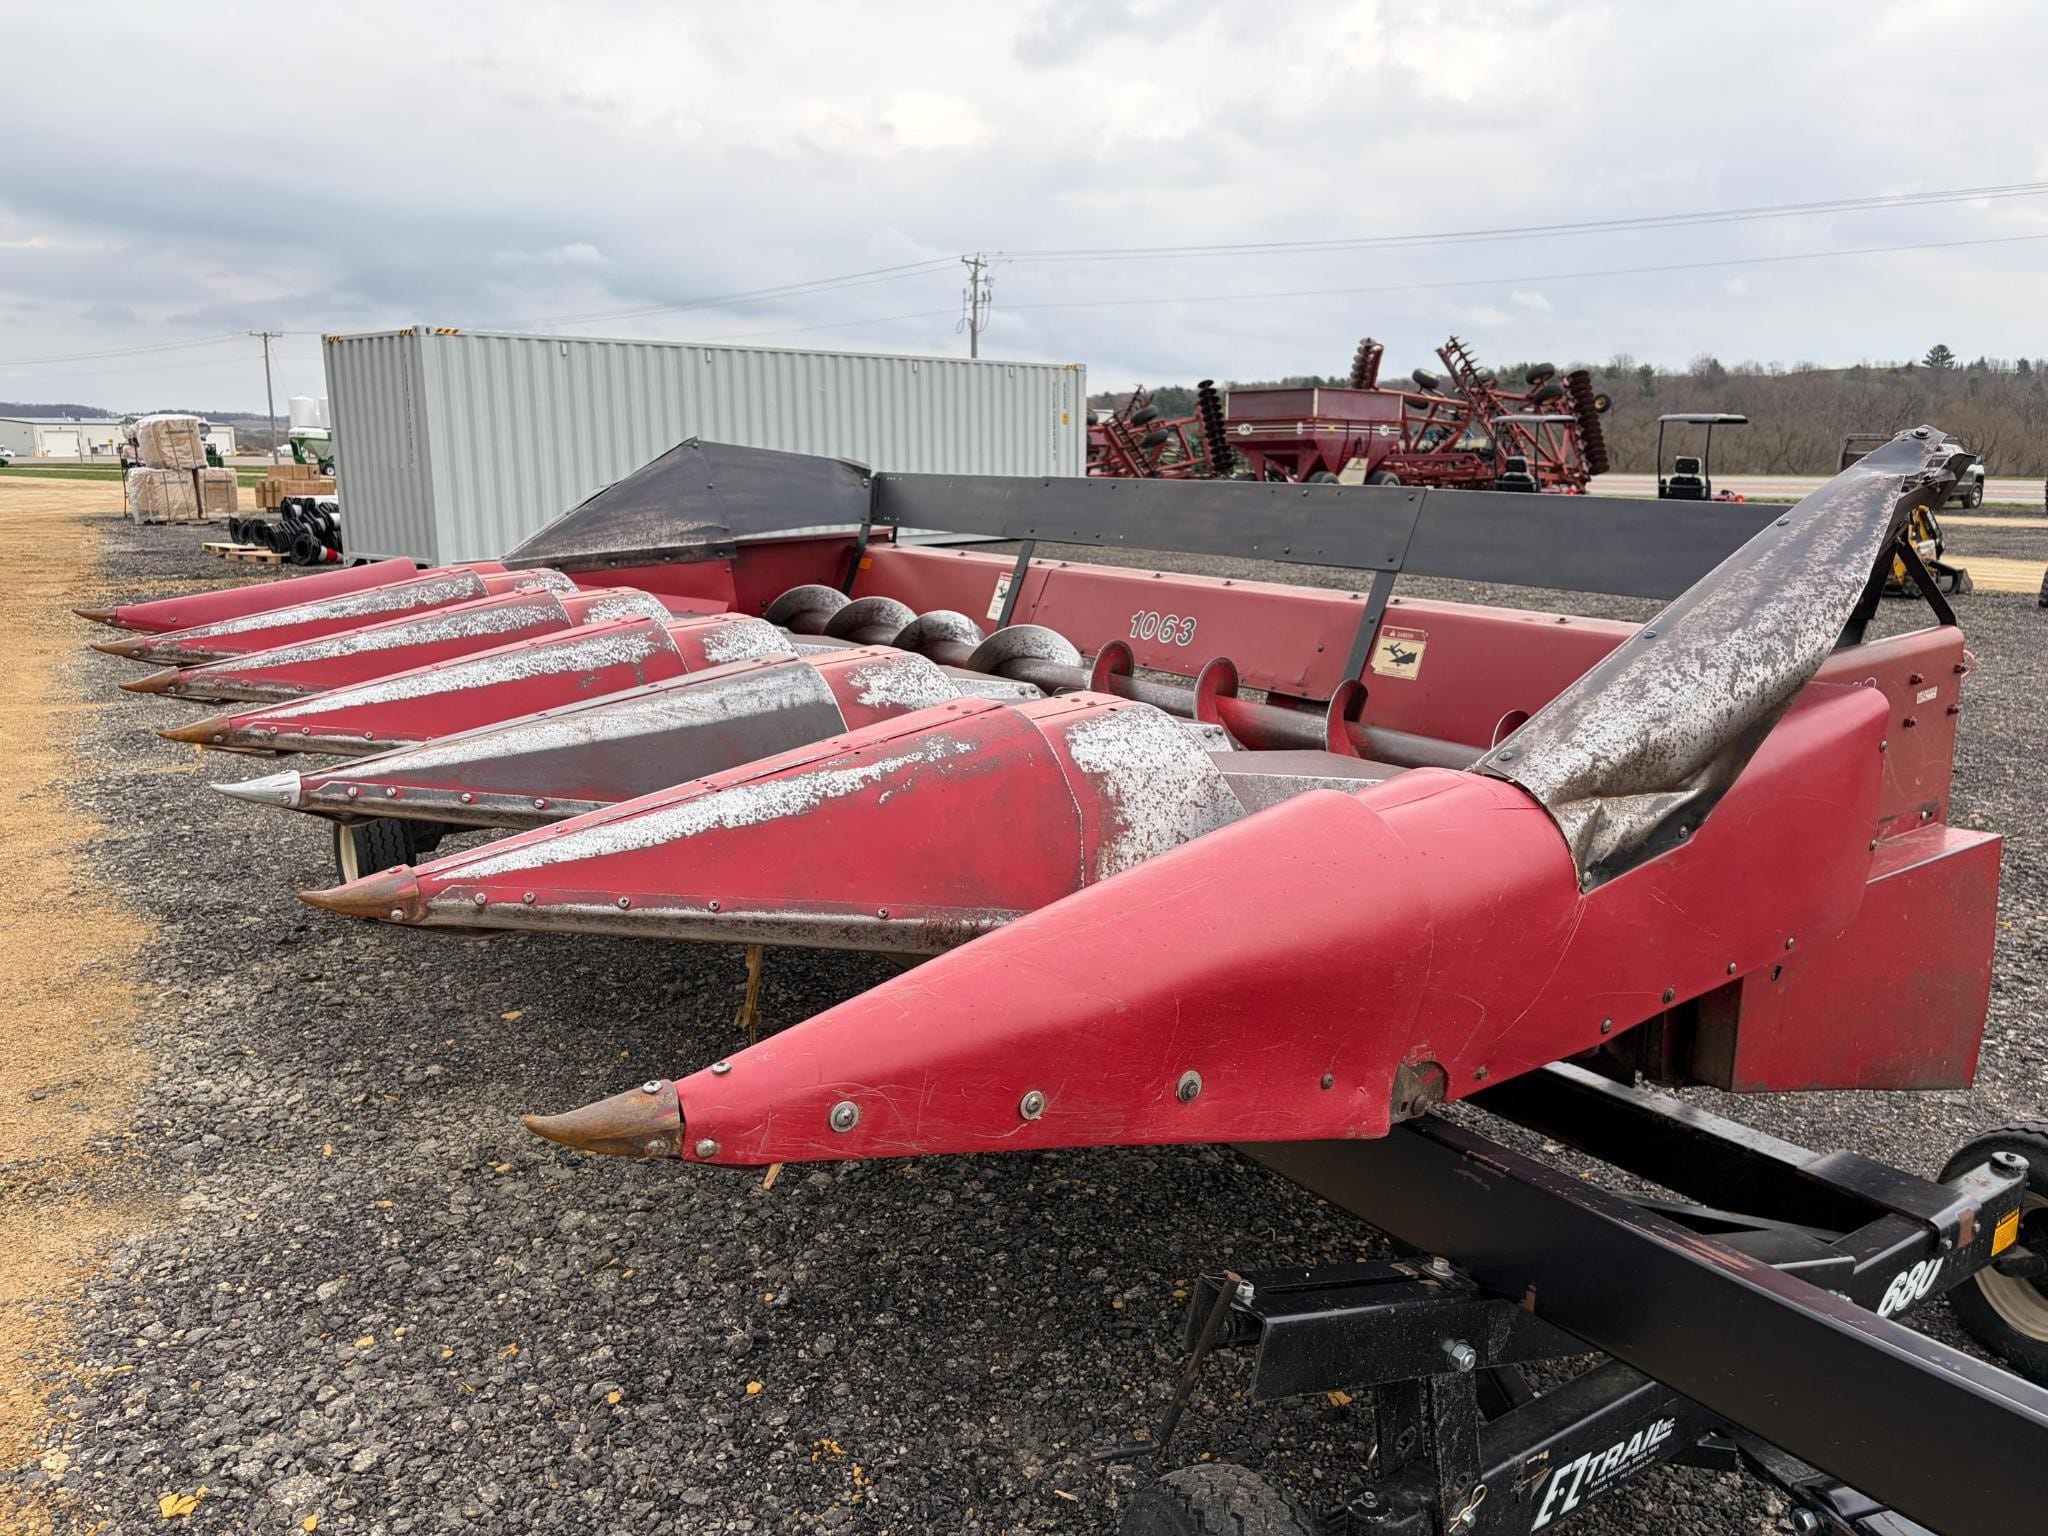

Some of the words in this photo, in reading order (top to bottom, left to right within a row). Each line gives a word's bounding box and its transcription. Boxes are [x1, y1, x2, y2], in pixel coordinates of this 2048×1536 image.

[1129, 610, 1197, 647] 1063
[1584, 1418, 1673, 1485] TRAIL
[1590, 1474, 1607, 1489] FARM
[1607, 1460, 1630, 1479] WAGONS
[1632, 1450, 1648, 1464] SINCE
